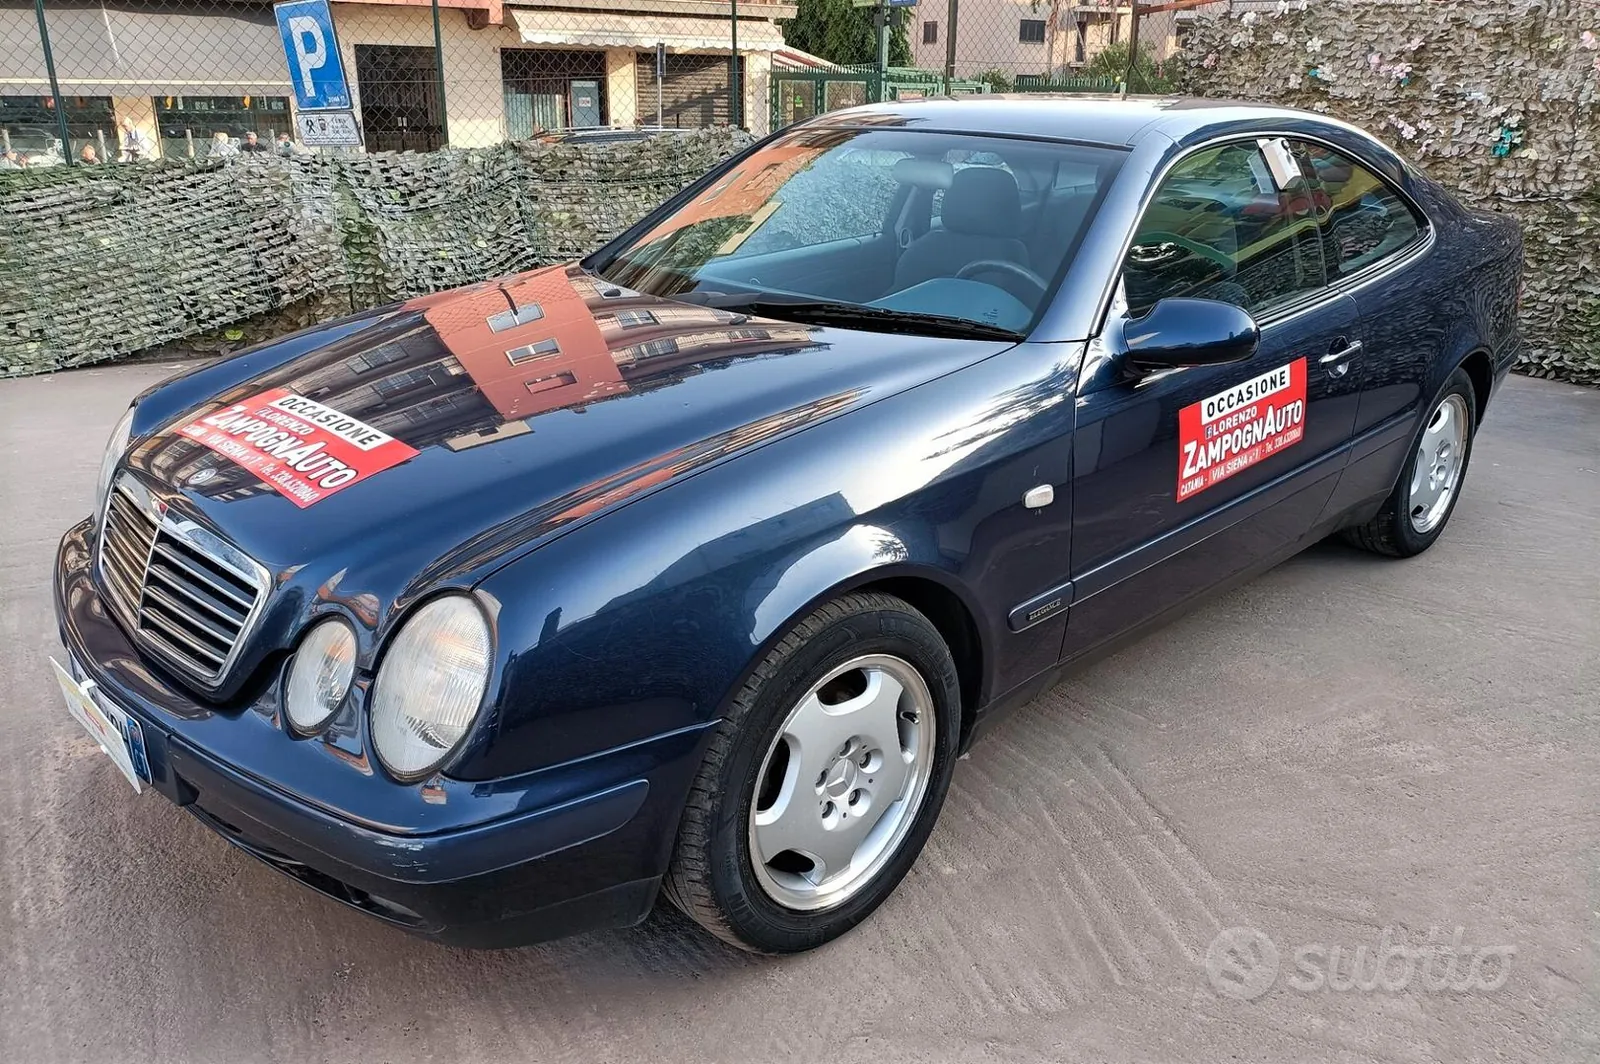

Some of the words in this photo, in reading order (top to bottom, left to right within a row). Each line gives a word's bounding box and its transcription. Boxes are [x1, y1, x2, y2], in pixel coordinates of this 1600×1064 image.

[288, 16, 327, 97] P
[1207, 370, 1287, 418] OCCASIONE
[262, 411, 315, 436] LORENZO
[278, 397, 382, 446] OCCASIONE
[1213, 405, 1258, 435] LORENZO
[1180, 474, 1204, 497] CATANIA
[1212, 465, 1225, 481] VIA
[1226, 454, 1248, 474] SIENA
